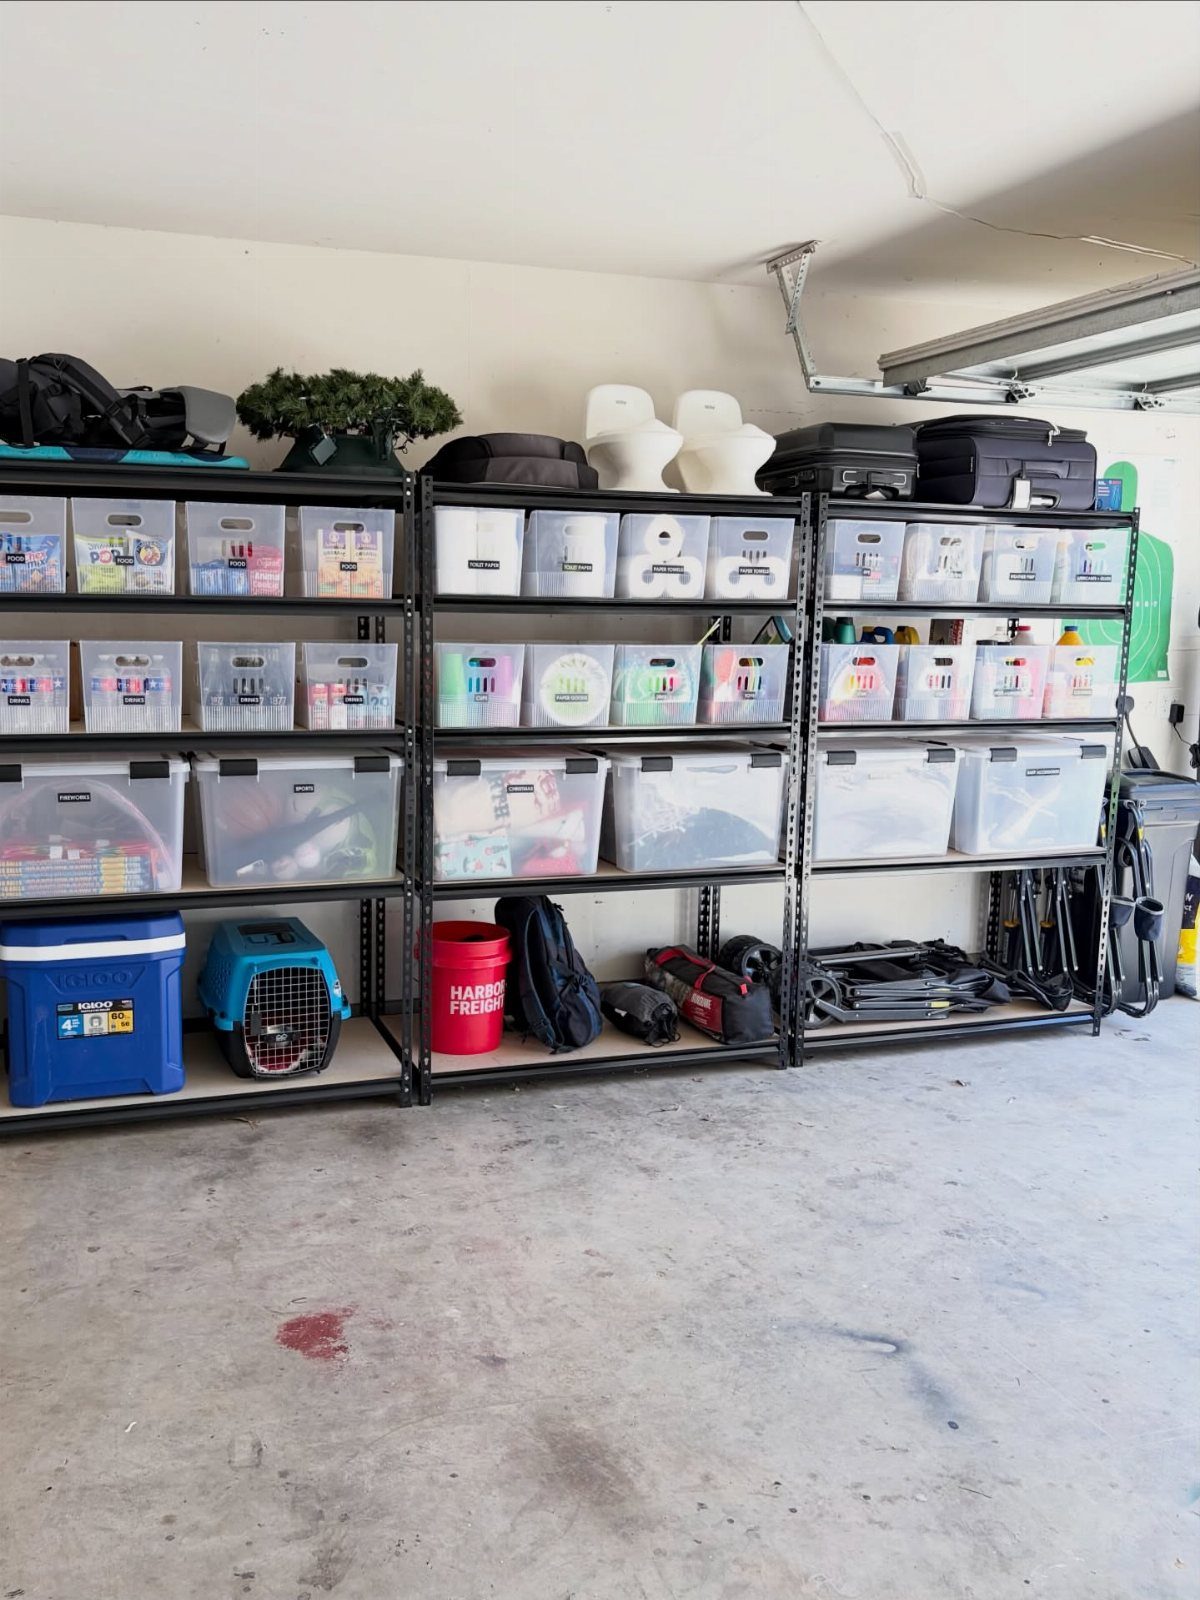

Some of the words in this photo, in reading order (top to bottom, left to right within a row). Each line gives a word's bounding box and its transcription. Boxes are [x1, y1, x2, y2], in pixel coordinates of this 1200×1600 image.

[78, 1001, 113, 1010] IGLOO
[450, 994, 504, 1015] FREIGHT
[111, 1012, 125, 1020] 60
[61, 1018, 73, 1031] 4
